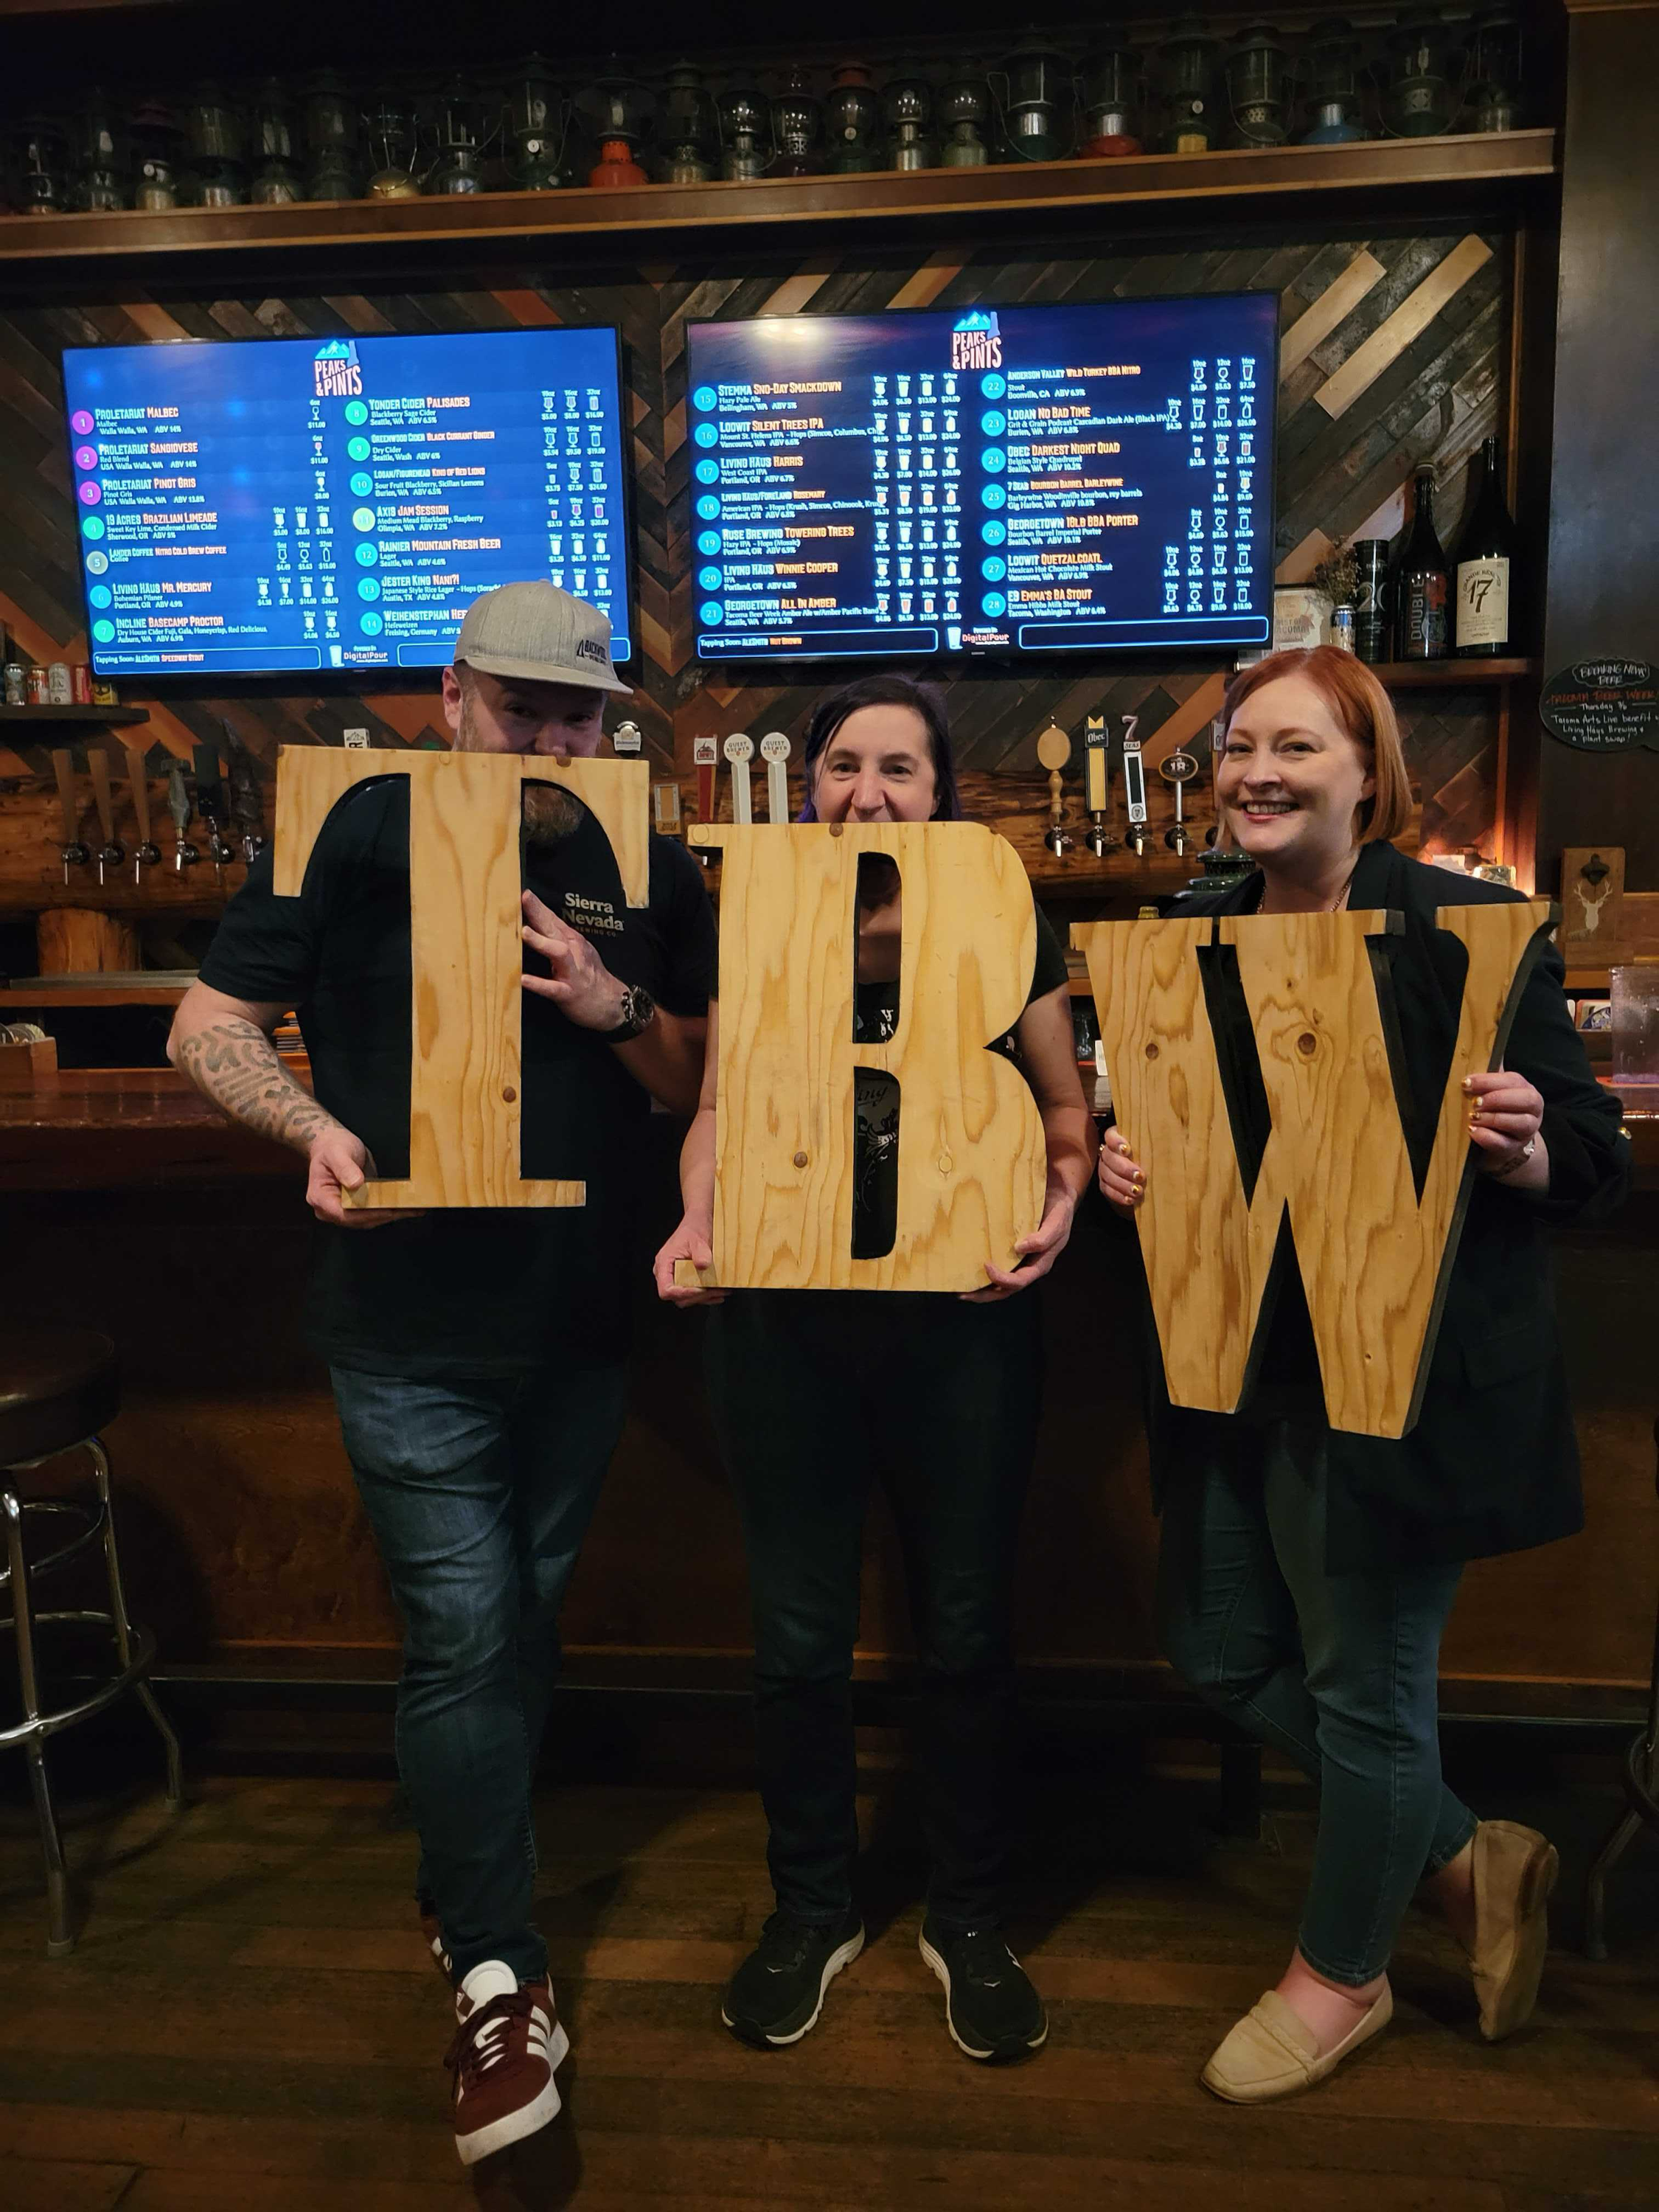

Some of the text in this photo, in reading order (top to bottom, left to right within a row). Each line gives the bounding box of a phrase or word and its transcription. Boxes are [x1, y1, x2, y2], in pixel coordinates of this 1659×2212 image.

[953, 332, 986, 355] PEAKS
[315, 360, 346, 382] PEAKS
[147, 407, 178, 419] MALBEC
[810, 419, 824, 429] IPA
[153, 479, 177, 489] PINOT
[1107, 515, 1138, 526] PORTER
[411, 540, 451, 552] MOUNTAIN
[453, 540, 479, 550] FRESH
[479, 539, 501, 549] BEER
[1467, 579, 1493, 613] 17
[1411, 578, 1424, 640] DOUBLE
[1551, 712, 1651, 724] Tacoma Arts Live benefit
[1579, 703, 1613, 712] Thursday
[1121, 715, 1138, 741] 7
[1563, 726, 1584, 736] Living
[1609, 726, 1637, 735] Brewing
[566, 892, 613, 913] Sierra
[562, 908, 625, 931] Nevada
[274, 744, 650, 1208] T
[674, 821, 1047, 1293] B
[1069, 902, 1551, 1440] W
